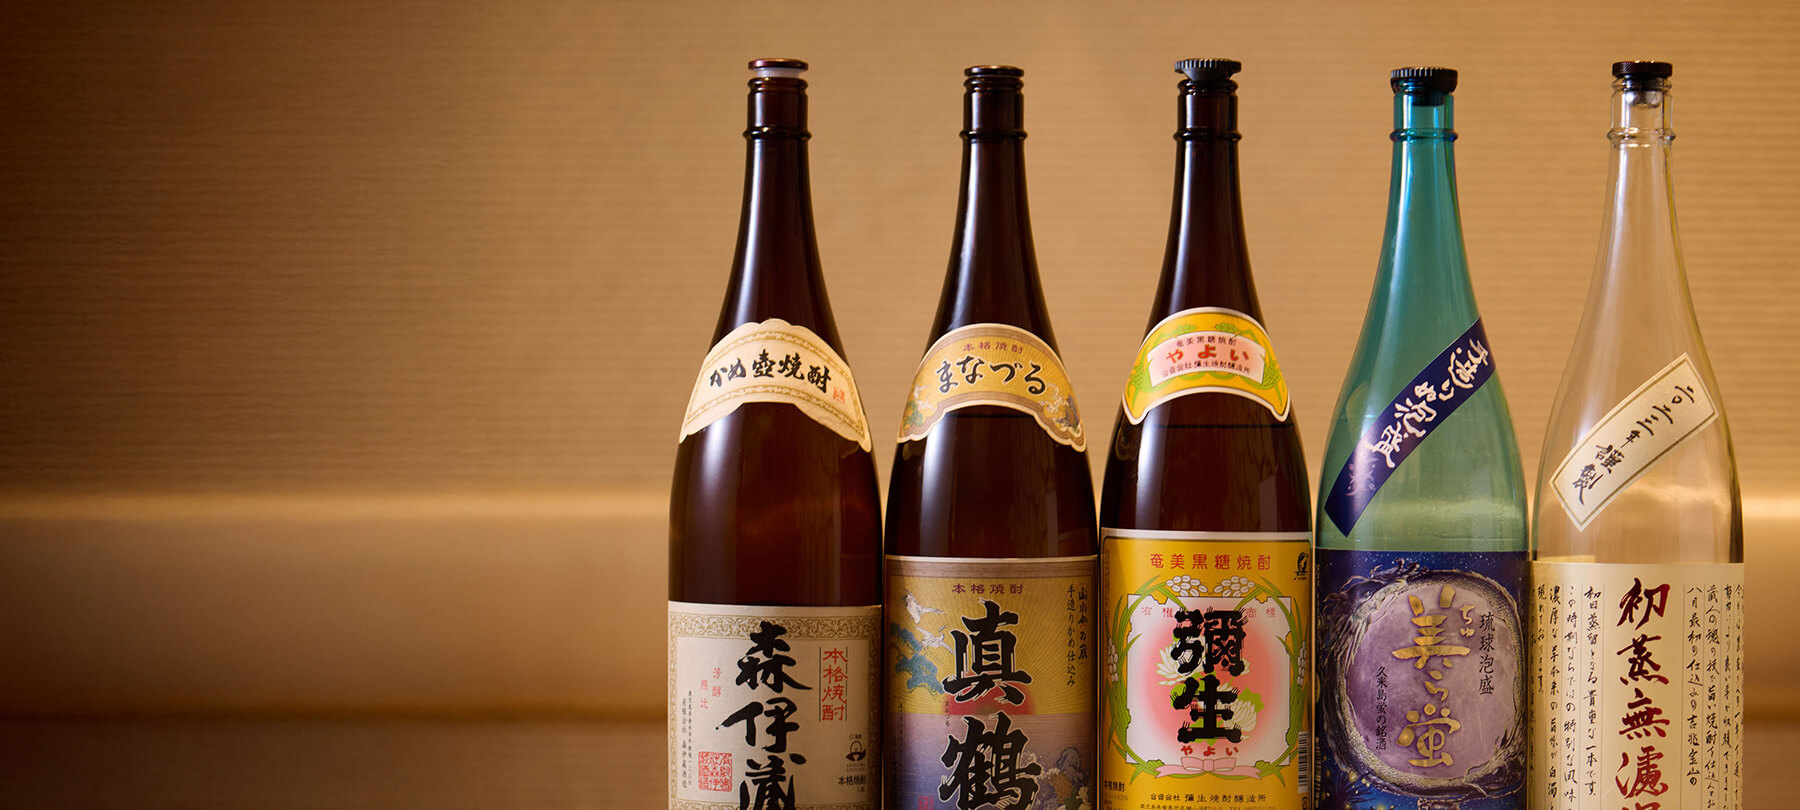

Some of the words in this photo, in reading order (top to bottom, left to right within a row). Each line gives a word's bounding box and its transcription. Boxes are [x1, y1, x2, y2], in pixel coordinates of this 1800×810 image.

[963, 341, 1024, 354] 本格焼酎
[1165, 344, 1249, 364] やよい
[936, 356, 1046, 394] まなづる
[1150, 553, 1272, 571] 奄美黒糖焼酎
[952, 583, 1024, 595] 本格焼酎
[1479, 611, 1496, 696] 琉球泡盛
[1615, 577, 1671, 810] 初蒸無濾
[1181, 746, 1240, 759] やよい
